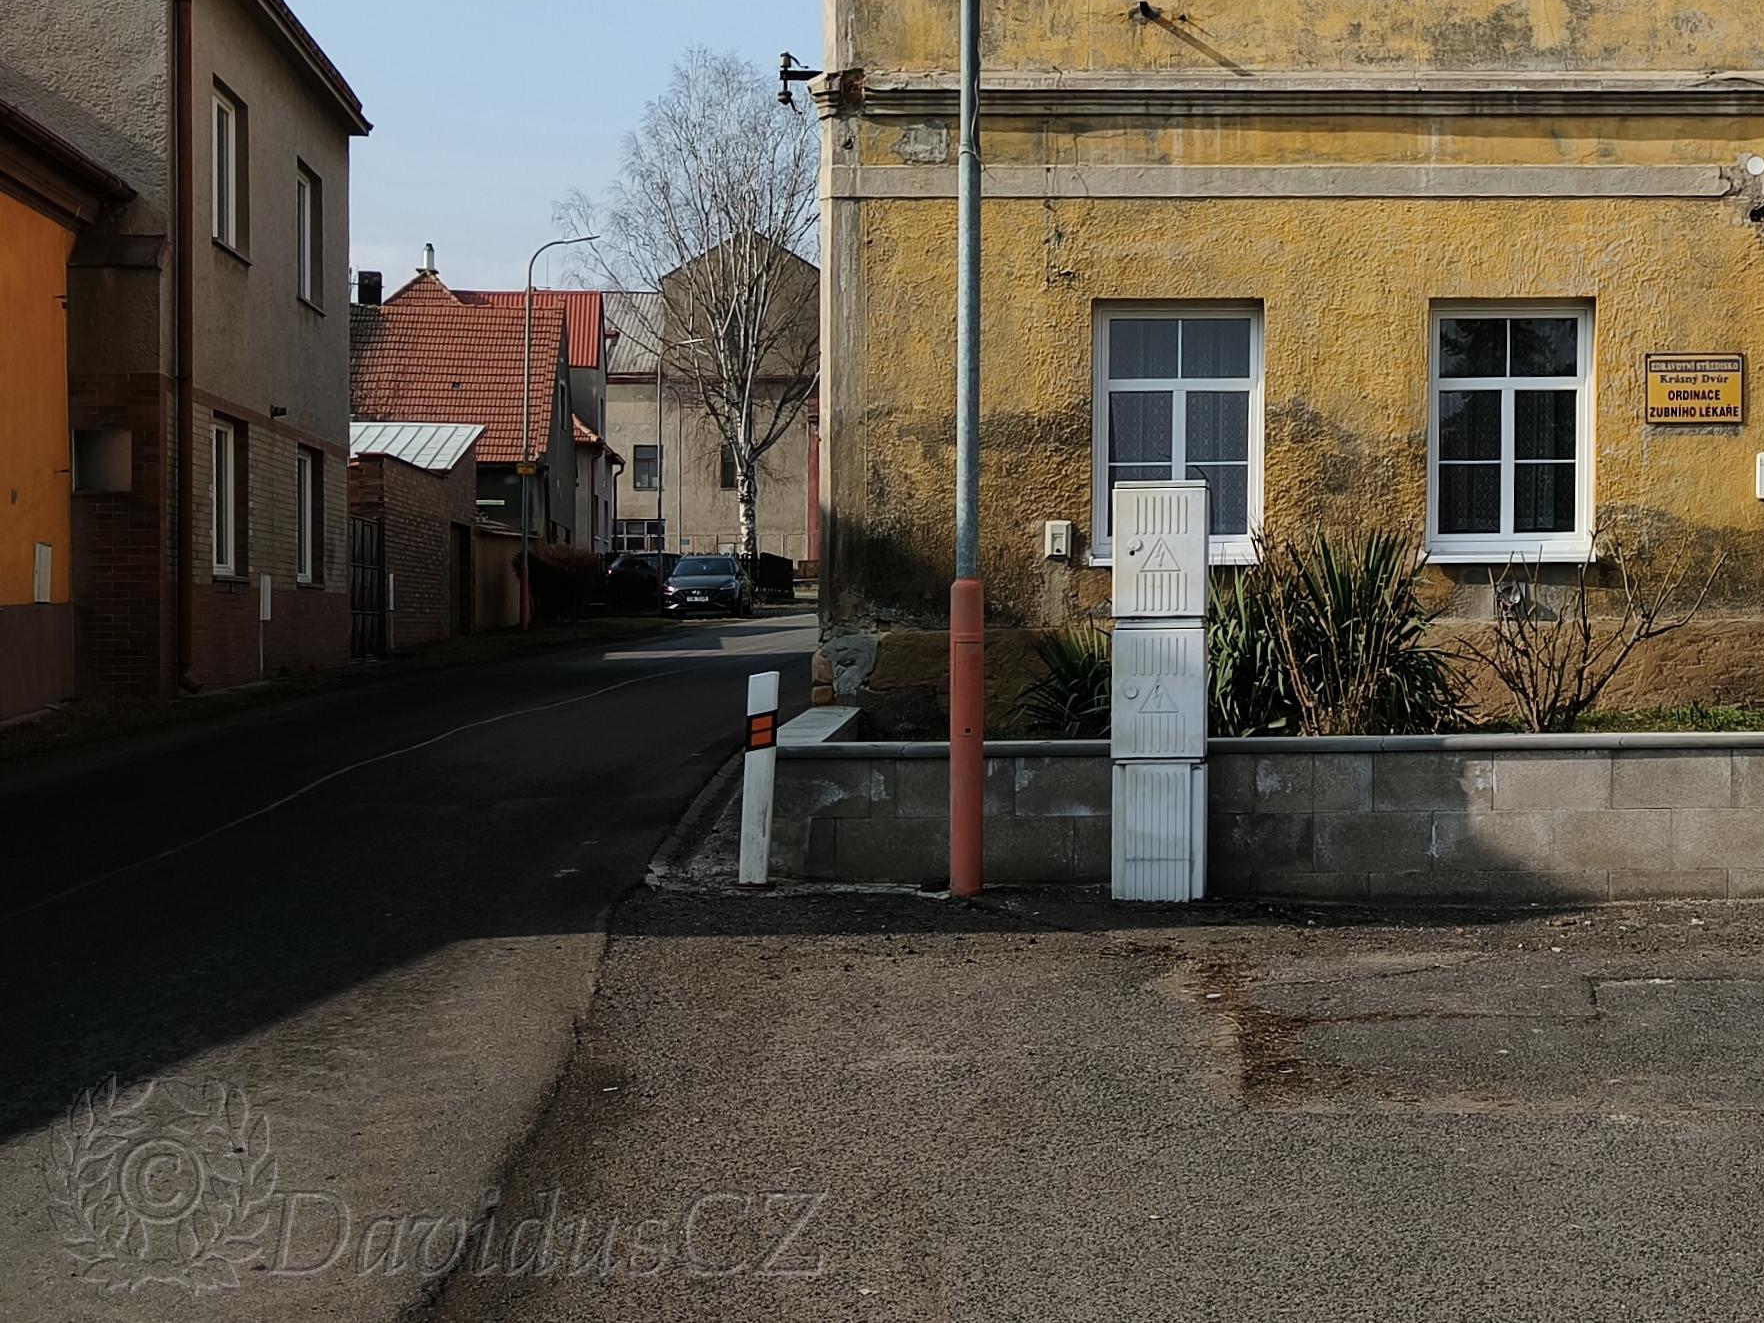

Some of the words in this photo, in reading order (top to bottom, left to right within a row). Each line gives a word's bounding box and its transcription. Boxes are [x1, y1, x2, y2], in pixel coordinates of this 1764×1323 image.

[1650, 361, 1695, 371] ZDRAVOTNÍ
[1660, 374, 1698, 384] Krásný
[1668, 390, 1721, 401] ORDINACE
[1650, 404, 1696, 417] ZUBNÍHO
[1699, 404, 1739, 417] LÉKAŘE
